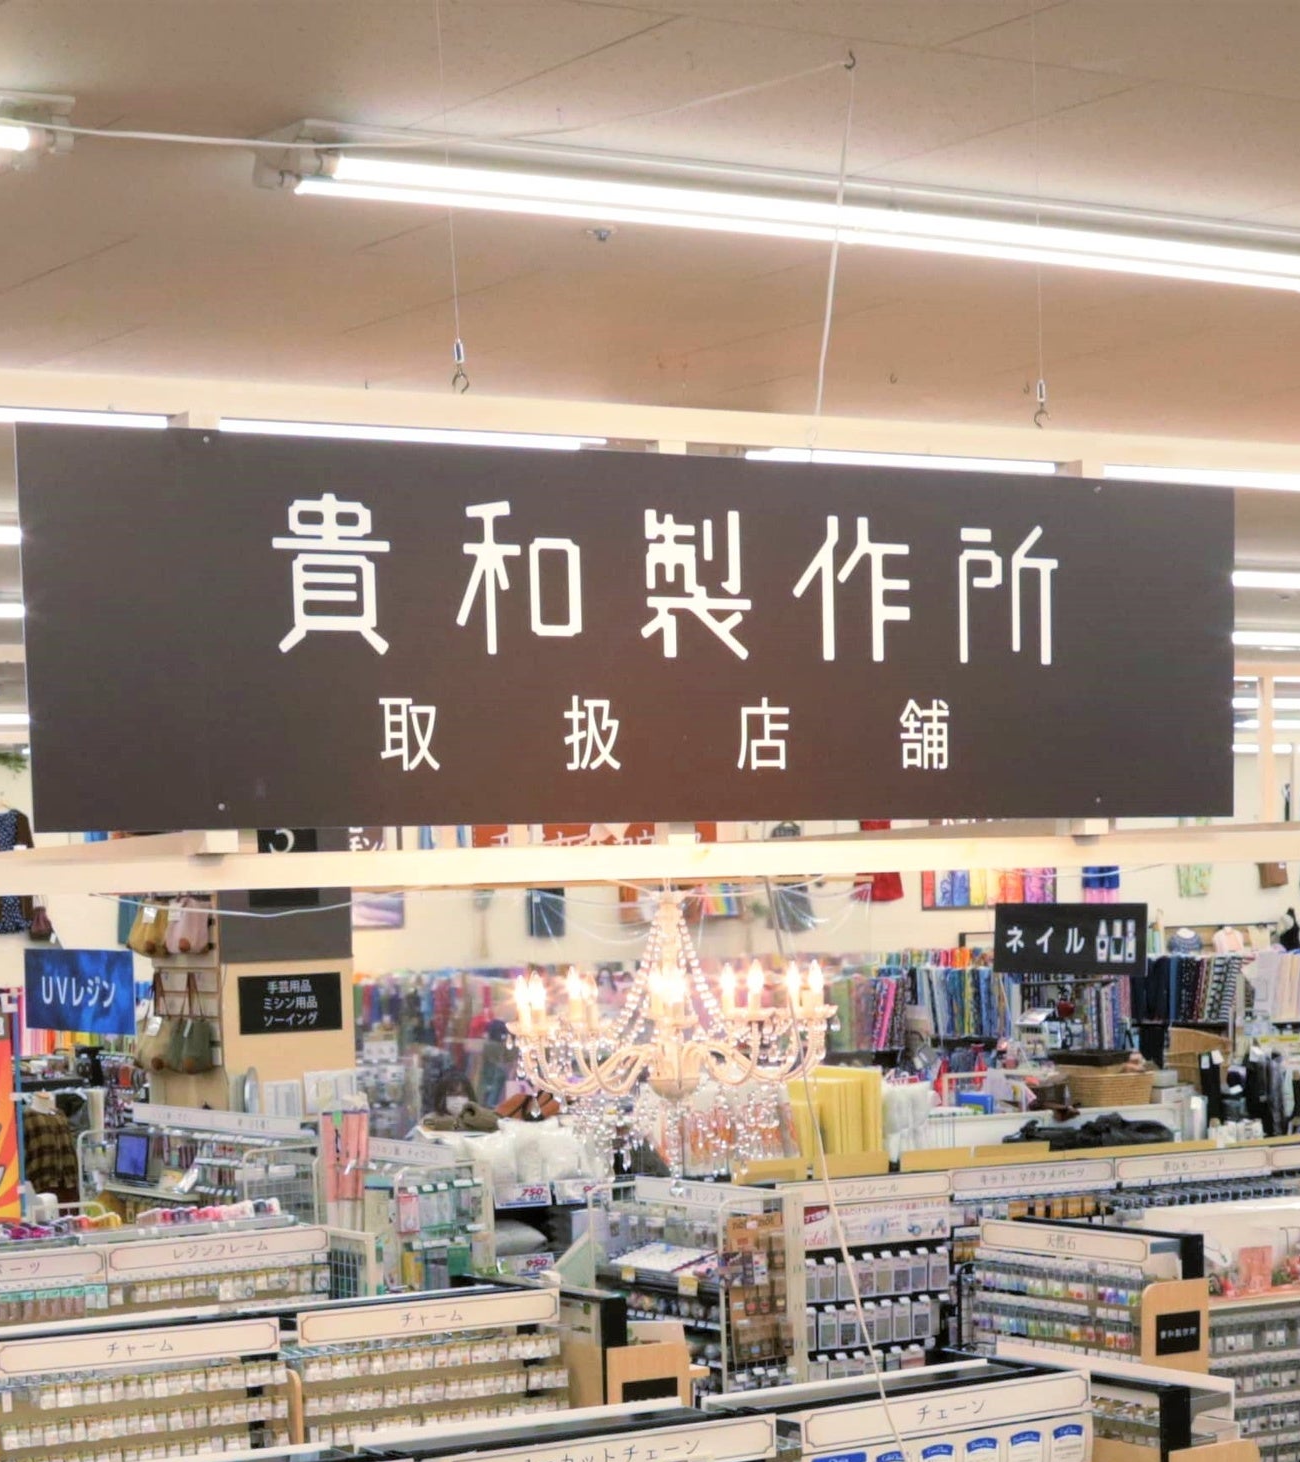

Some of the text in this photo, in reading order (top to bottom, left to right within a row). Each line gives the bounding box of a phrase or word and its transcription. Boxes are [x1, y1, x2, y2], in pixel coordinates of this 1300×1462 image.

[271, 491, 1059, 667] 貴和製作所
[378, 694, 950, 771] 取扱店舗
[1005, 926, 1086, 955] ネイル
[41, 974, 116, 1006] UVレジン
[267, 979, 312, 993] 手芸用品
[263, 995, 318, 1010] ミシン用品
[264, 1011, 318, 1027] ソーイング
[401, 1308, 464, 1326] チャーム
[106, 1338, 175, 1358] チャーム
[916, 1399, 986, 1425] チェーン
